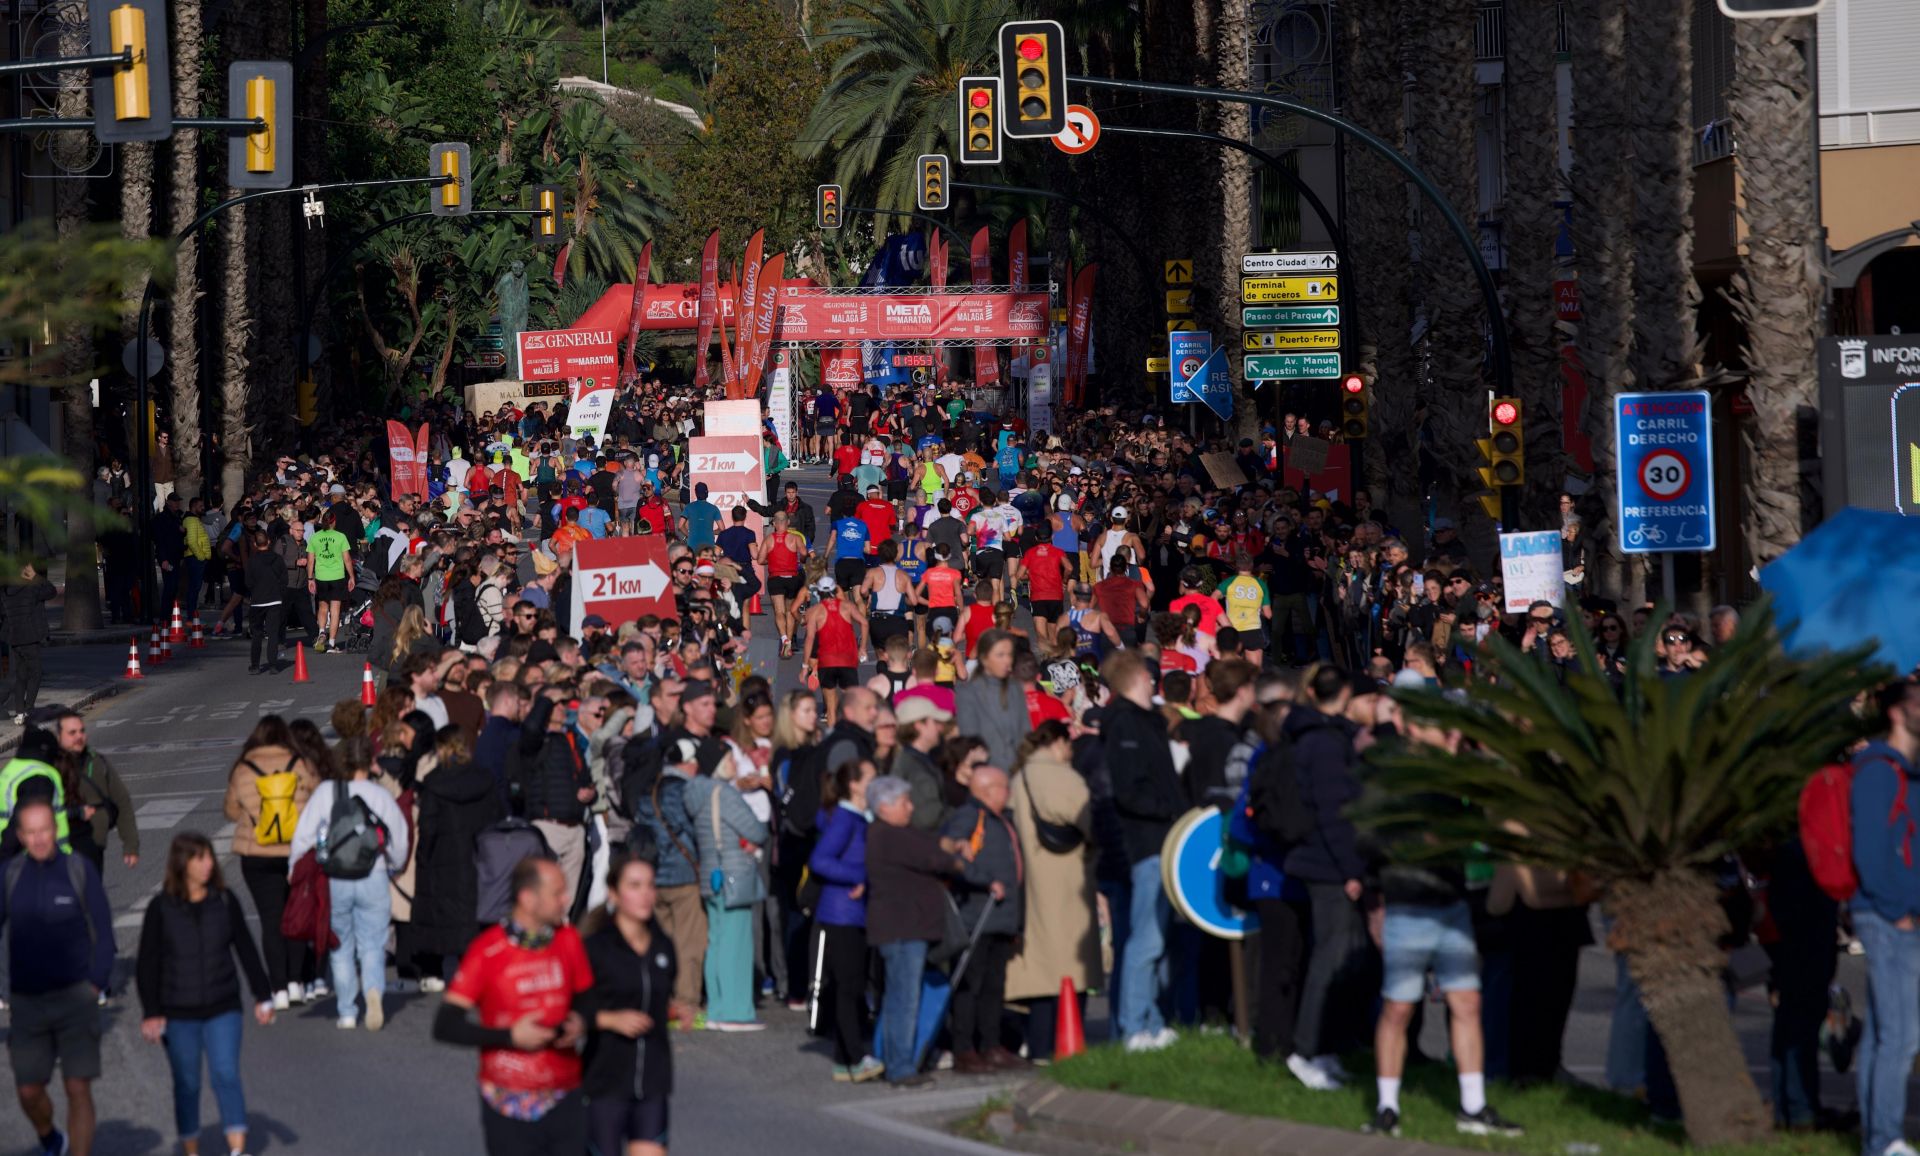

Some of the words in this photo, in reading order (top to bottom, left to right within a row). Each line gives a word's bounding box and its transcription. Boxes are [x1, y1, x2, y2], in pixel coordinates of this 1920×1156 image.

[1244, 259, 1274, 267] Centro
[1276, 258, 1307, 266] Ciudad
[1245, 281, 1286, 289] Terminal
[1262, 291, 1301, 299] cruceros
[757, 286, 778, 334] Vitality
[886, 304, 931, 316] META
[1245, 312, 1272, 320] Paseo
[1274, 311, 1288, 320] del
[1291, 311, 1322, 321] Parque
[1008, 322, 1044, 331] GENERALI
[545, 331, 613, 348] GENERALI
[578, 354, 614, 366] MARATÓN
[1303, 356, 1337, 365] Manuel
[1184, 364, 1199, 373] 30
[1302, 366, 1338, 375] Heredia
[1622, 401, 1704, 416] ATENCIÓN
[579, 410, 602, 420] renfe
[1636, 418, 1689, 430] CARRIL
[1628, 432, 1698, 445] DERECHO
[1649, 465, 1680, 484] 30
[1624, 504, 1708, 518] PREFERENCIA
[1501, 532, 1561, 558] LAURA
[1234, 585, 1258, 600] 58
